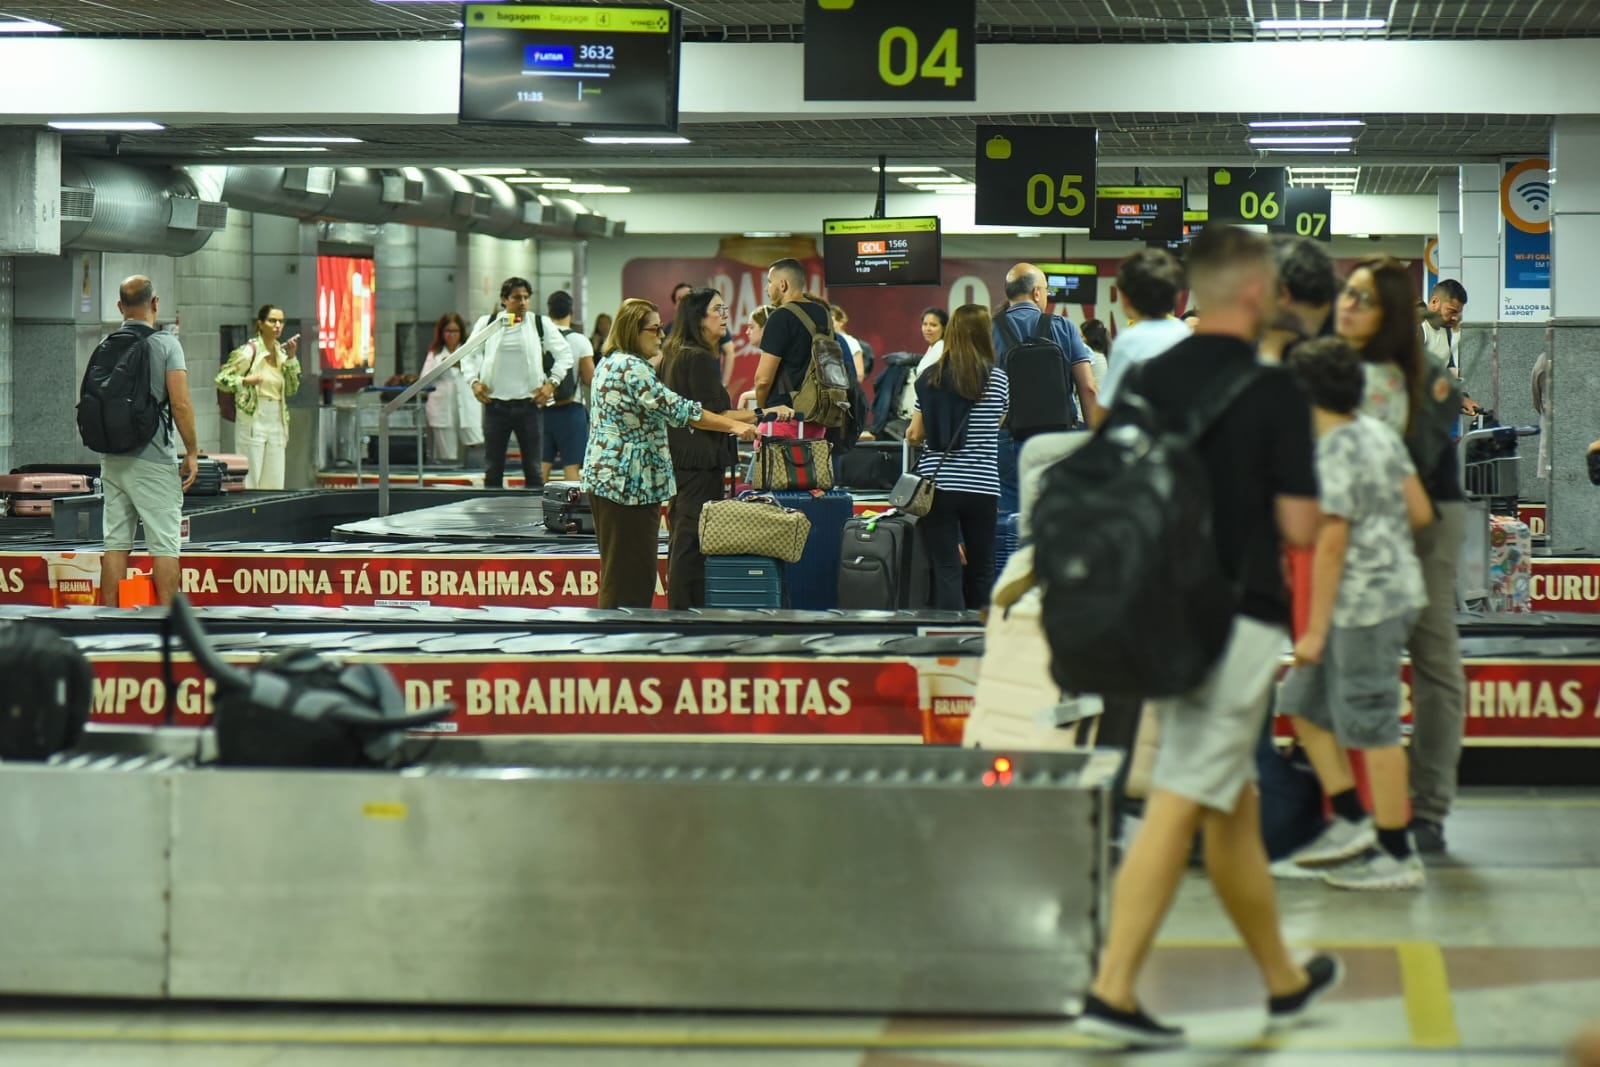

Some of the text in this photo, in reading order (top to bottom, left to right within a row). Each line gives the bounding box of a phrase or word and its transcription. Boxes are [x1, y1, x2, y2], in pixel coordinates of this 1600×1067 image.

[497, 11, 541, 22] bagagem
[579, 45, 614, 60] 3632
[878, 26, 963, 87] 04
[1026, 174, 1085, 216] 05
[1240, 191, 1280, 219] 06
[1120, 205, 1137, 214] GOL
[1142, 203, 1158, 211] 1314
[1296, 213, 1327, 236] 07
[861, 239, 908, 253] GOL 1566
[60, 581, 91, 593] BRAHMA
[340, 562, 373, 595] TÁ
[379, 569, 414, 595] DE
[421, 570, 555, 596] BRAHMAS
[405, 679, 453, 716] DE
[466, 677, 663, 716] BRAHMAS
[673, 677, 851, 716] ABERTAS
